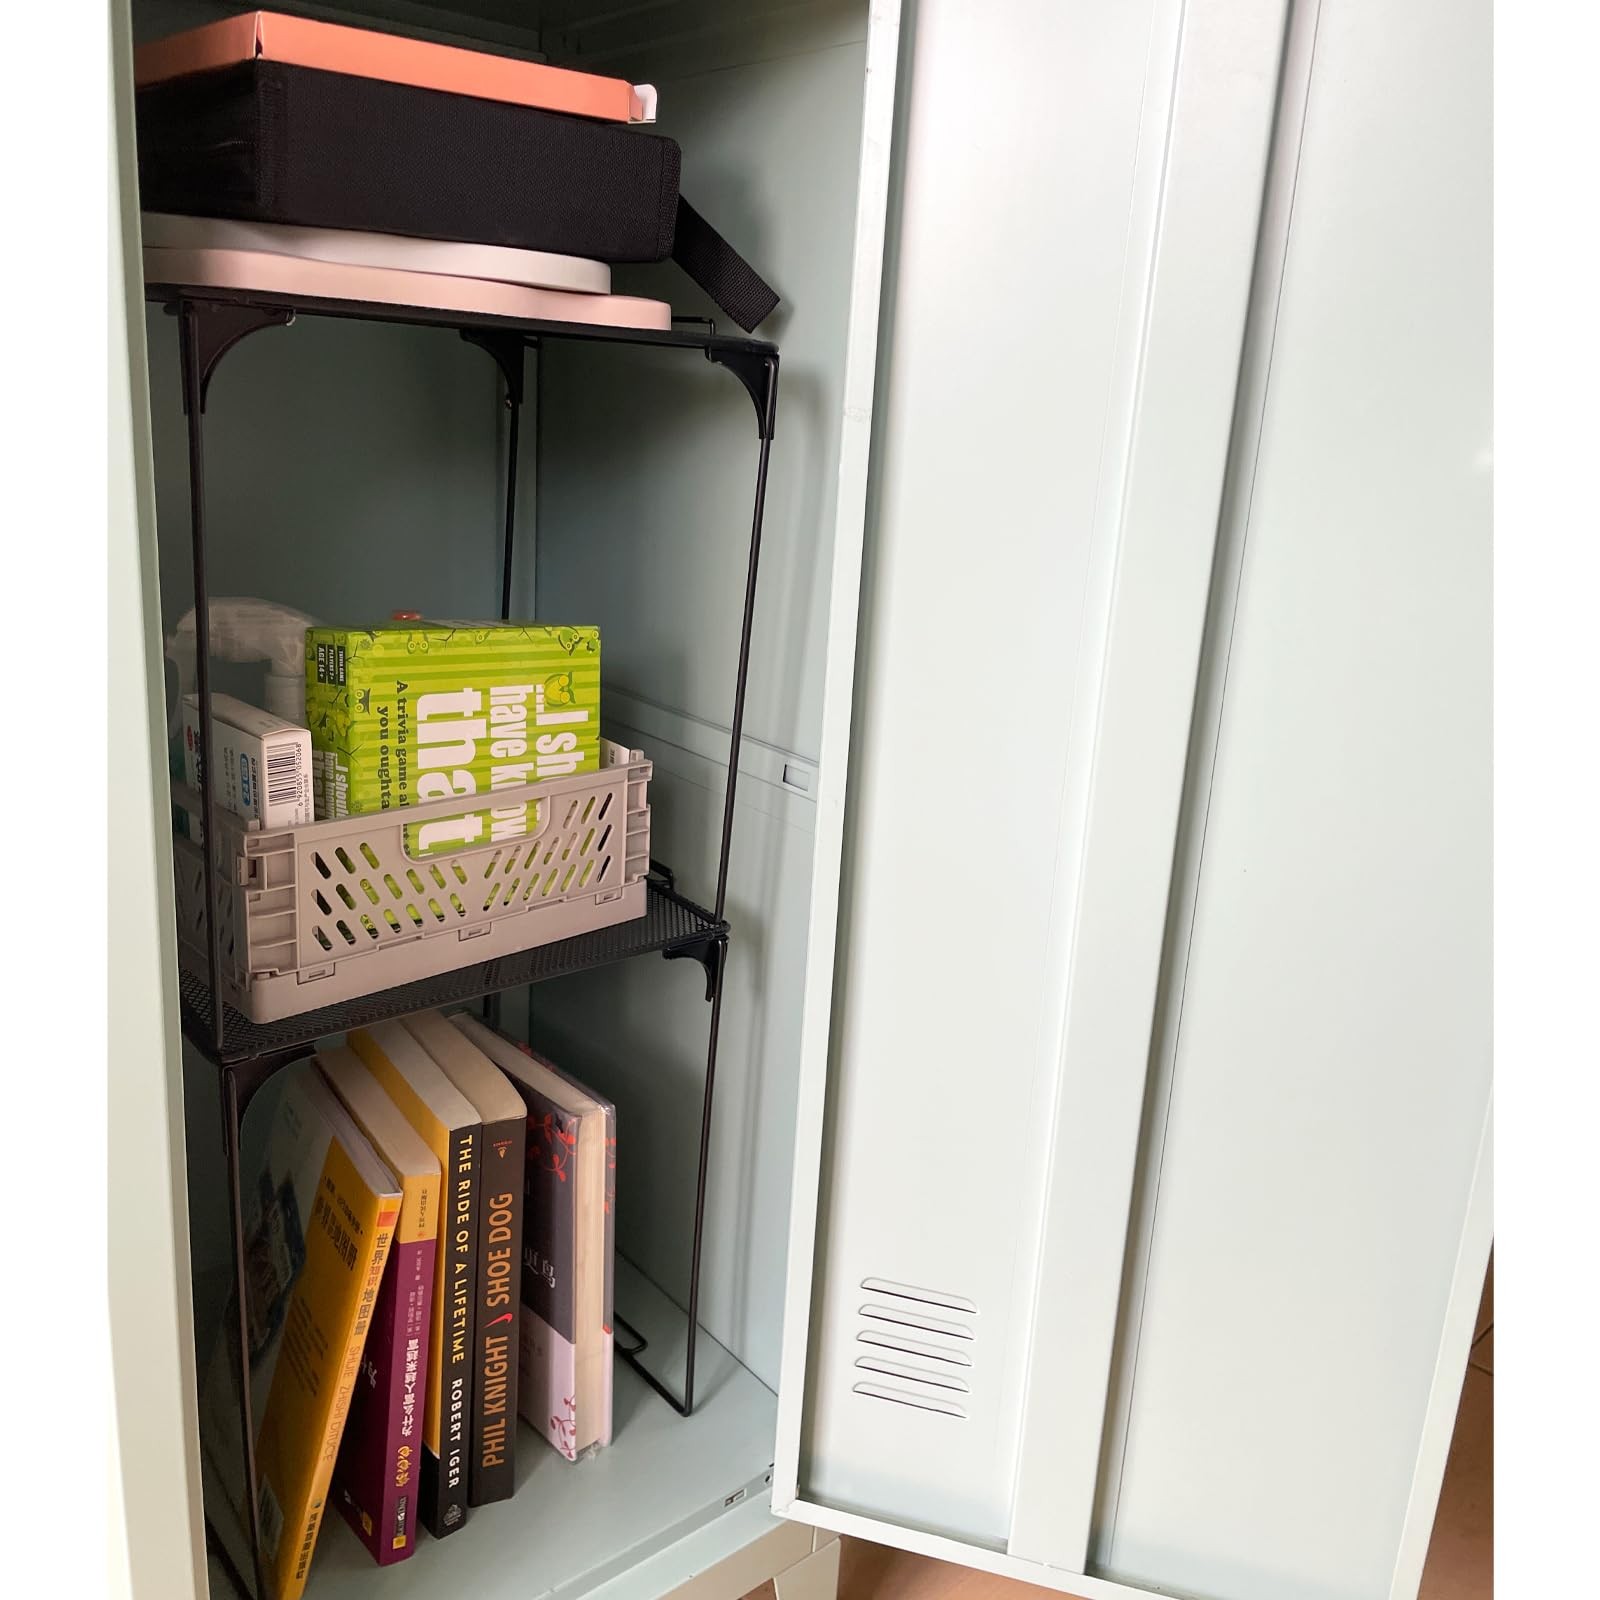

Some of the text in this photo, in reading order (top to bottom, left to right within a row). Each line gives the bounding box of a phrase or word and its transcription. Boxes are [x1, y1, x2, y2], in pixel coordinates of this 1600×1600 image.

[396, 680, 408, 694] A
[397, 698, 409, 744] trivia
[490, 684, 534, 758] have
[324, 752, 336, 779] have
[377, 706, 392, 810] you oughta
[396, 748, 408, 790] game
[416, 687, 487, 857] that
[452, 1134, 473, 1364] THE RIDE OF A LIFETIME
[482, 1193, 513, 1469] PHIL KNIGHT SHOE DOG
[343, 1346, 361, 1377] SHIJIE
[333, 1385, 350, 1419] ZHISHI
[450, 1378, 463, 1442] ROBERT
[448, 1448, 461, 1489] IGER
